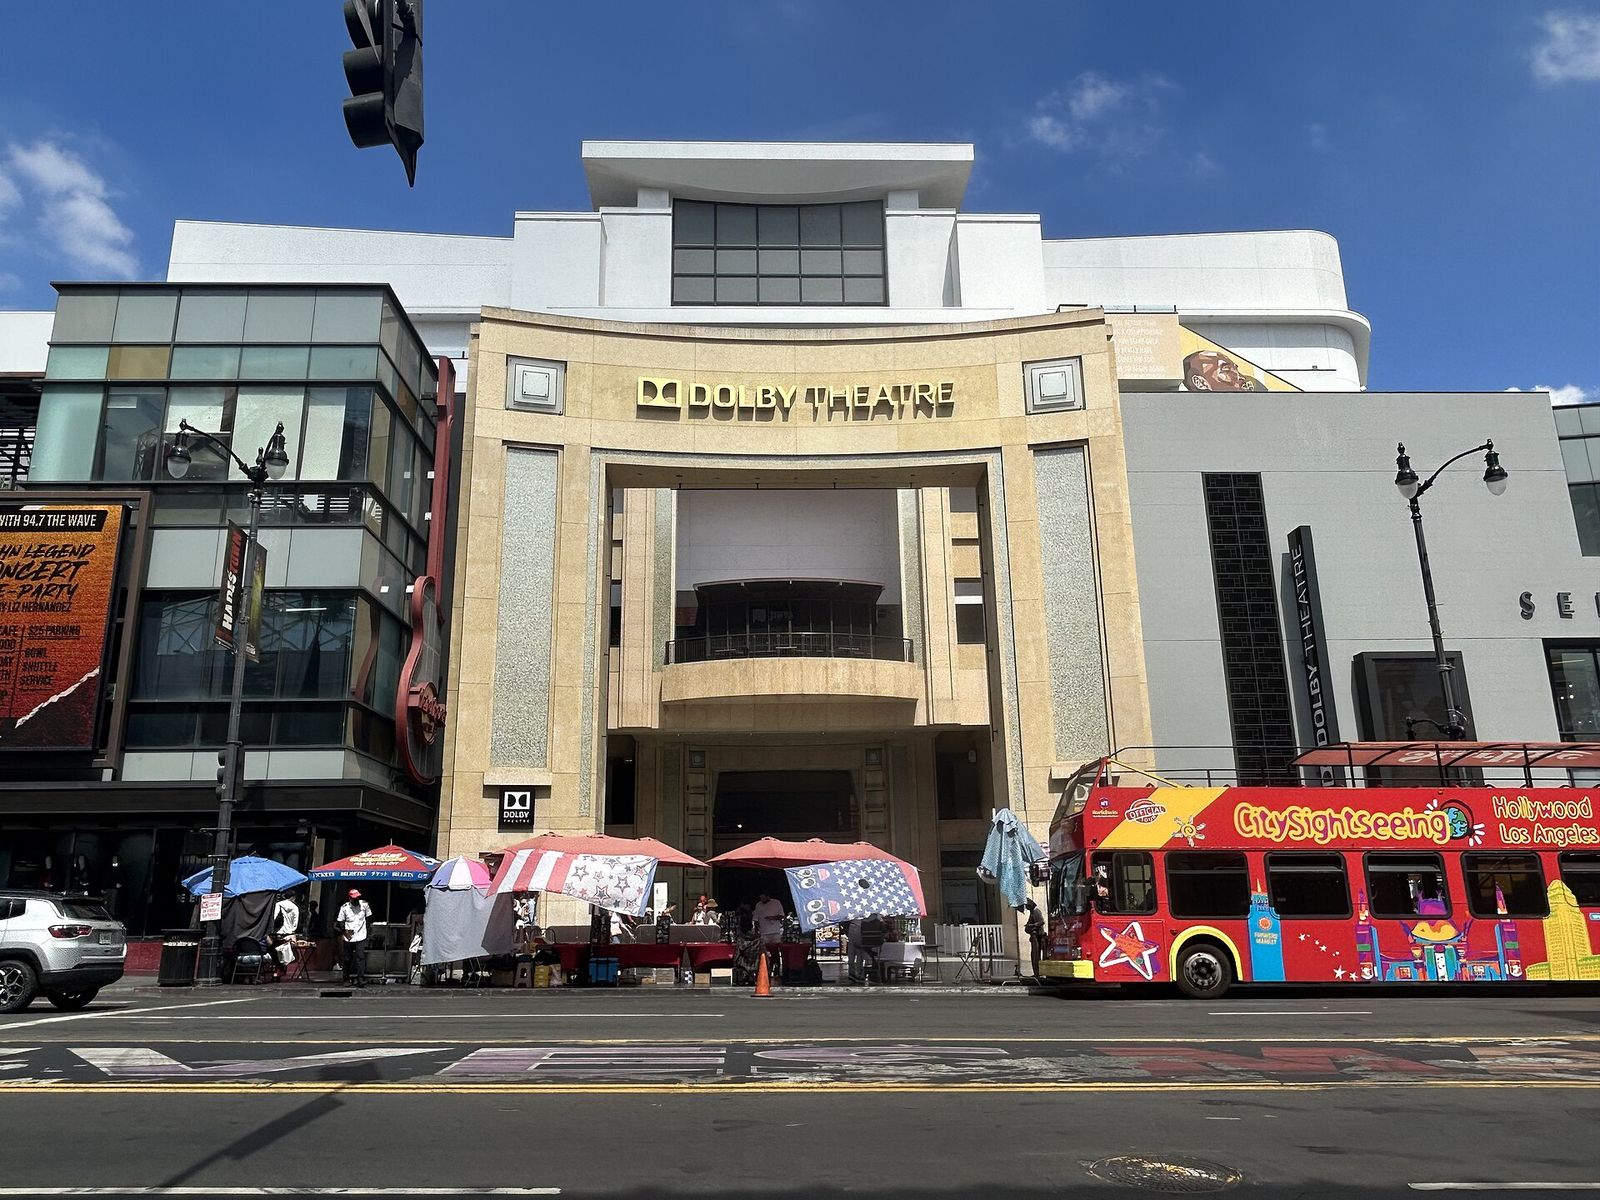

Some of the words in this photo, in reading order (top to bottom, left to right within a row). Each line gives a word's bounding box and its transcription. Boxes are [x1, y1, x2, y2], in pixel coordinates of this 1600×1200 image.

[689, 382, 797, 409] DOLBY
[806, 381, 955, 408] THEATRE
[23, 514, 45, 526] 94.7
[47, 515, 66, 526] THE
[68, 515, 97, 526] WAVE
[23, 544, 96, 558] LEGEND
[1292, 543, 1314, 657] THEATRE
[1519, 591, 1600, 620] SE
[1308, 664, 1328, 748] DOLBY
[1129, 805, 1165, 818] OFFICIAL
[1492, 796, 1593, 821] Hollywood
[1233, 802, 1451, 844] CitySightseeing
[1499, 823, 1531, 844] Los
[1533, 823, 1600, 847] Angeles
